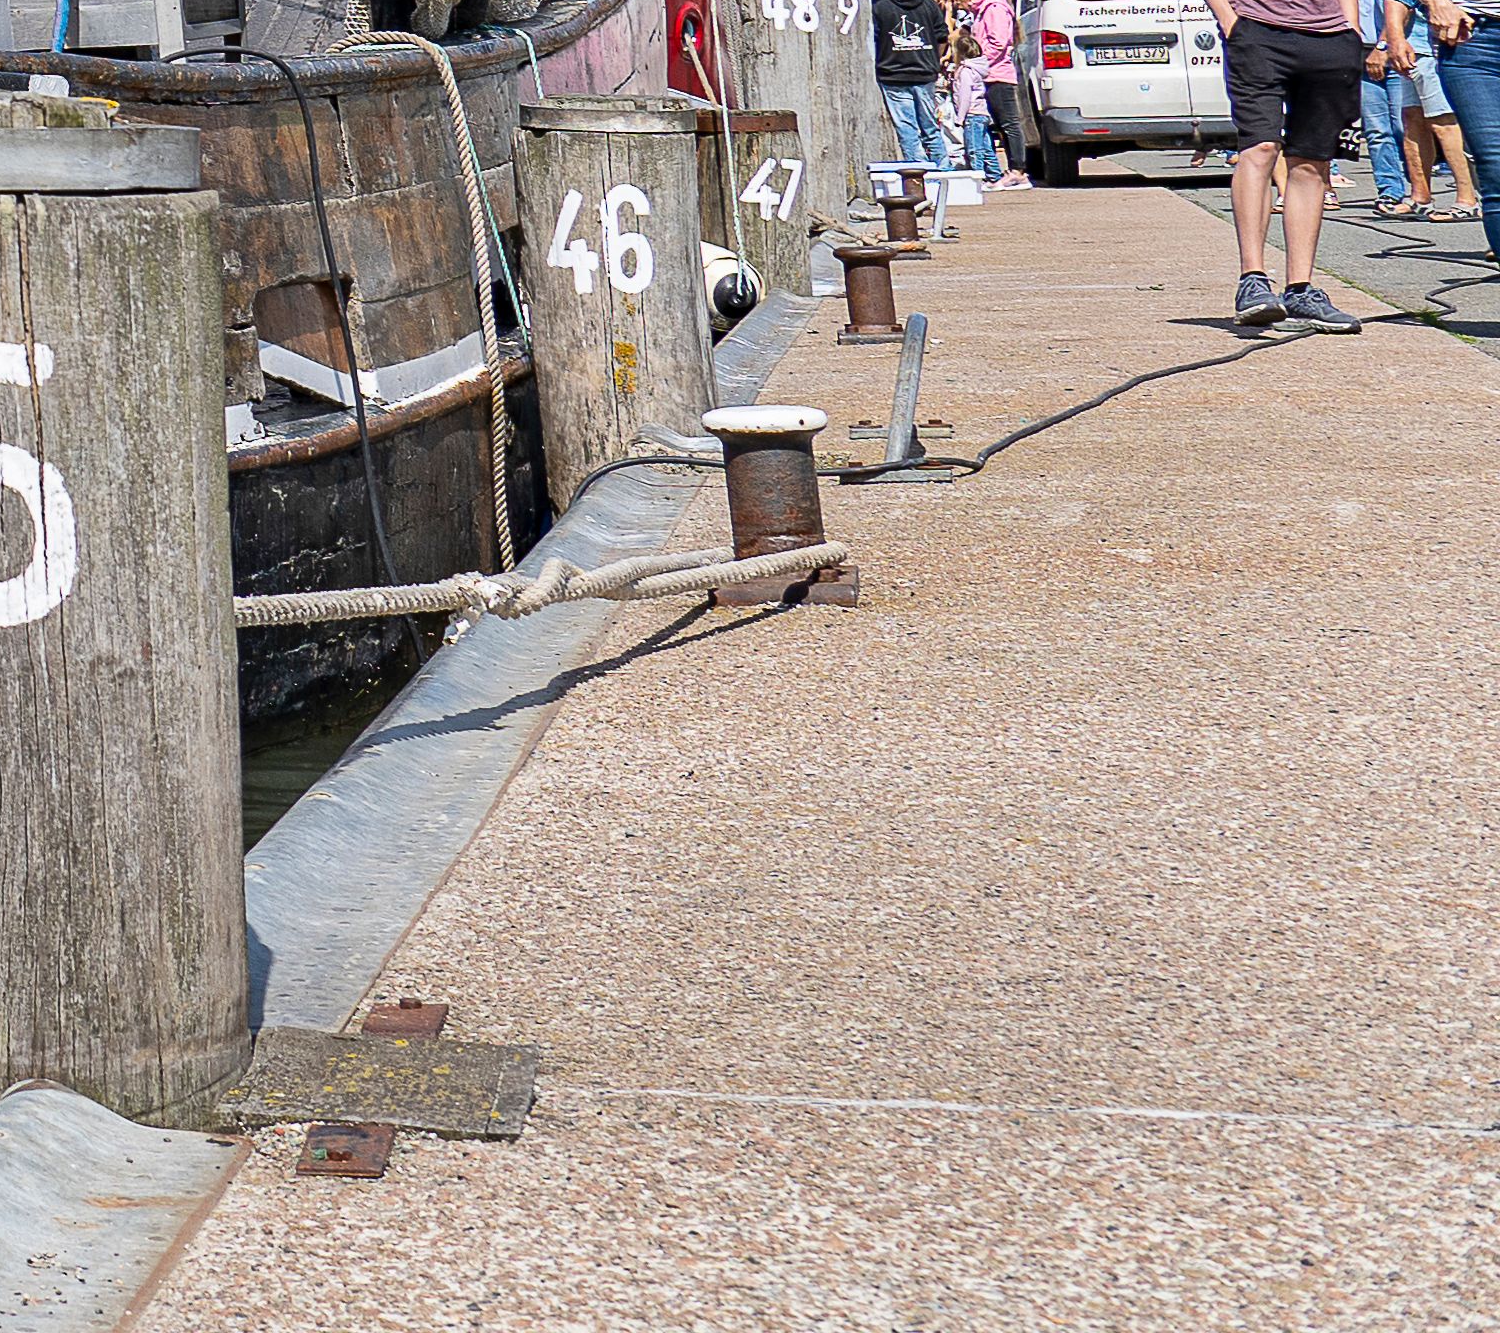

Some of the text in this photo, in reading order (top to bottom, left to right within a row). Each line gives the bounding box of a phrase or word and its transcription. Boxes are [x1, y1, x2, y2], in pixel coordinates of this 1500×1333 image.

[1079, 4, 1175, 16] Fischereibetrieb
[1191, 56, 1221, 65] 0174
[740, 156, 803, 223] 47
[547, 182, 655, 295] 46
